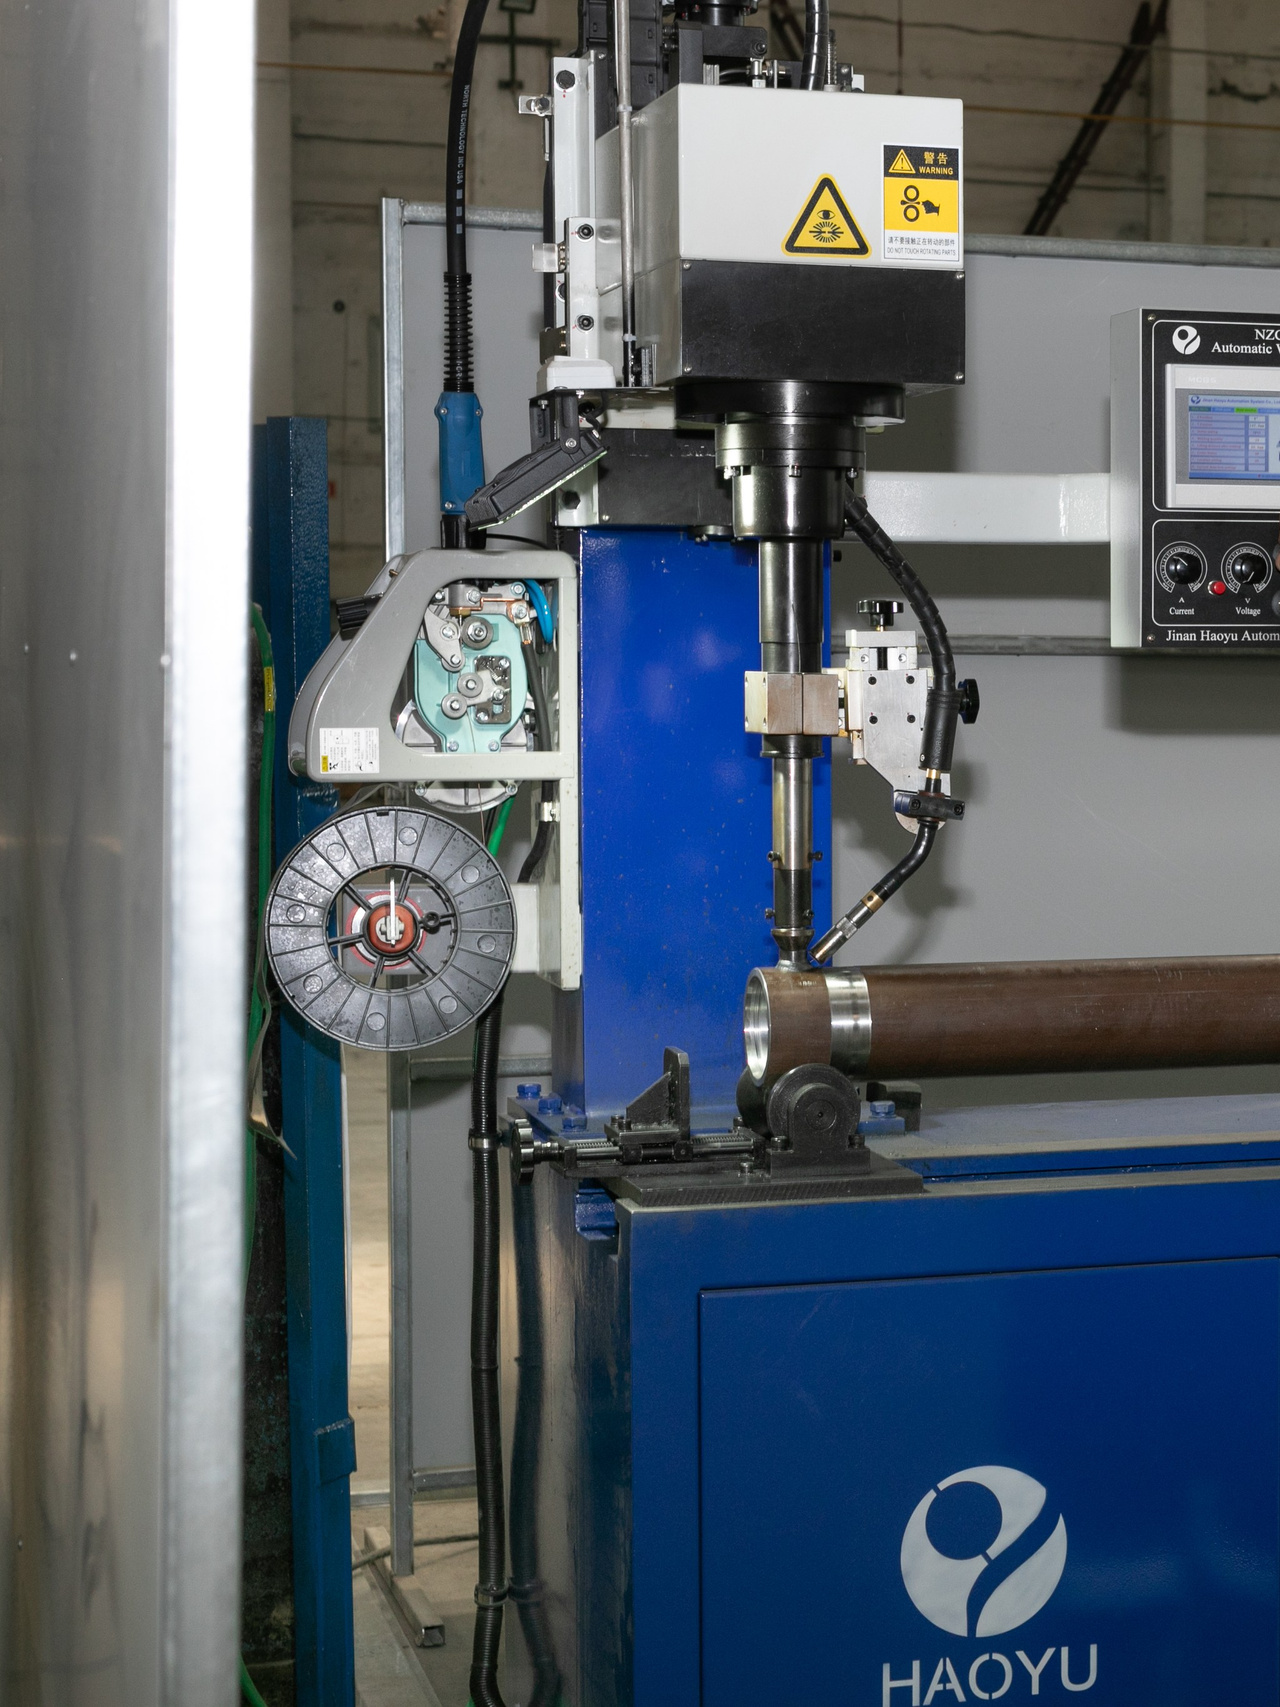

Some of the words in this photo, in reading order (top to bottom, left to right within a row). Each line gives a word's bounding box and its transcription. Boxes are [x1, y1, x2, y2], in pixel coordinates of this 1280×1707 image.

[462, 84, 471, 108] NORTH
[459, 109, 468, 154] TECHNOLOGY
[924, 151, 948, 165] 警告
[456, 169, 464, 185] USA
[918, 166, 954, 175] WARNING
[904, 247, 920, 255] TOUCH
[920, 248, 941, 256] ROTATING
[1211, 342, 1273, 355] Automatic
[1169, 607, 1195, 615] Current
[1235, 607, 1261, 616] Voltage
[1165, 629, 1197, 642] Jinan
[1200, 629, 1238, 644] Haoyu
[882, 1643, 1098, 1707] HAOYU
